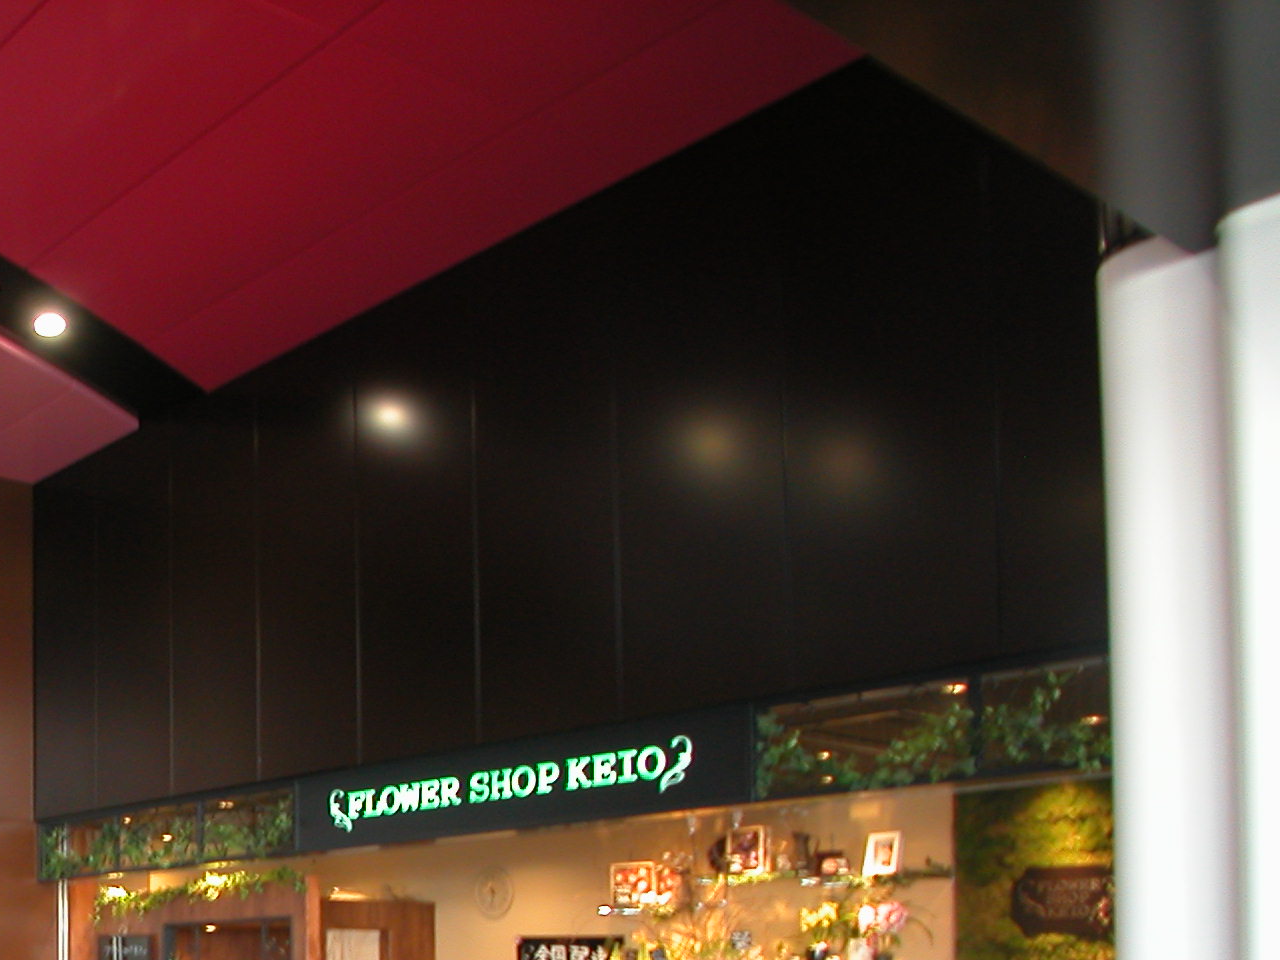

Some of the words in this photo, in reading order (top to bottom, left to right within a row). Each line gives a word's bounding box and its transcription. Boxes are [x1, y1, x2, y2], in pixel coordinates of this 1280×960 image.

[348, 776, 461, 819] FLOWER
[469, 761, 560, 803] SHOP
[565, 745, 666, 791] KEIO
